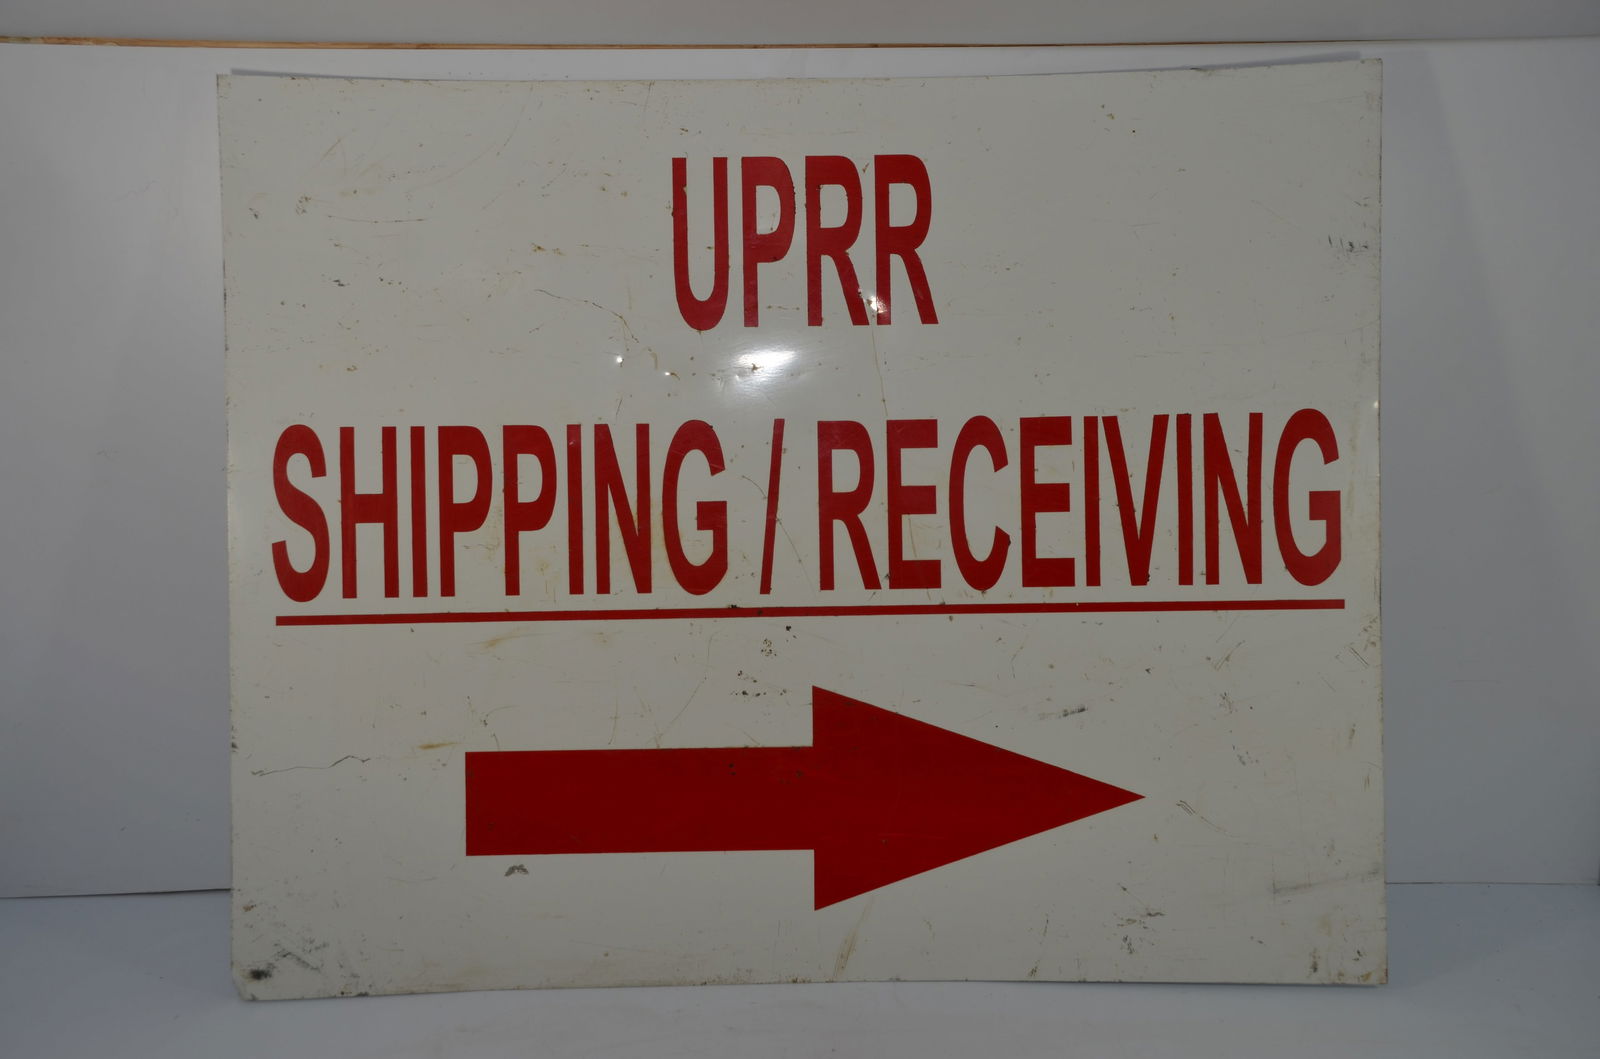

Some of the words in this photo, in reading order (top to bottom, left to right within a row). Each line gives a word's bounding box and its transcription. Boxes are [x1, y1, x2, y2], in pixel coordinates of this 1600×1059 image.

[672, 154, 938, 330] UPRR
[272, 420, 728, 602] SHIPPING
[818, 408, 1341, 591] RECEIVING
